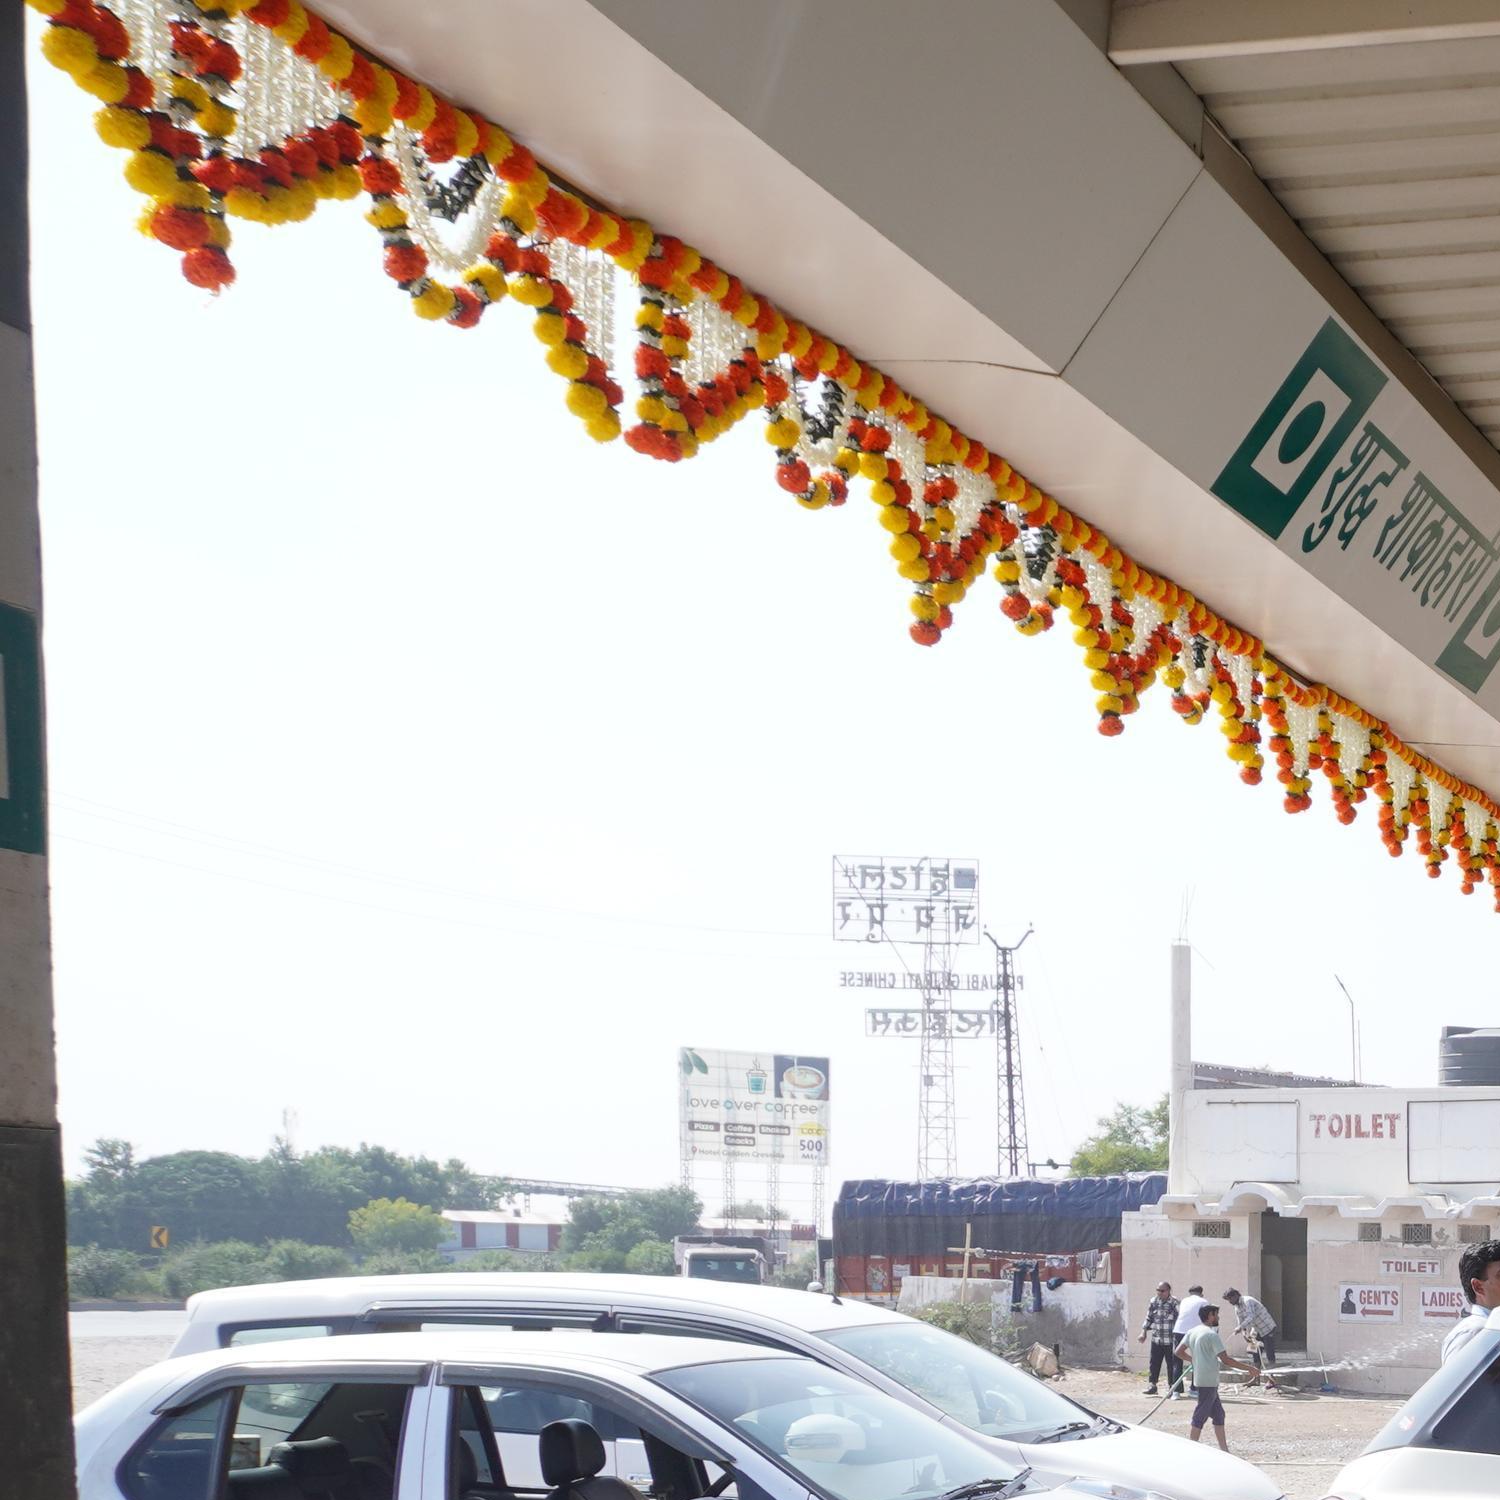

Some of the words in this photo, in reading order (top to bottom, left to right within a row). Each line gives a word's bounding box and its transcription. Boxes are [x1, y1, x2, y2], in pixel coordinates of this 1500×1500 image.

[685, 1088, 720, 1108] love
[723, 1100, 762, 1111] over
[764, 1102, 818, 1120] coffee
[1309, 1113, 1401, 1139] TOILET
[799, 1139, 823, 1151] 500
[1382, 1260, 1439, 1273] TOILET
[1359, 1289, 1399, 1305] GENTS
[1421, 1291, 1463, 1307] LADIES
